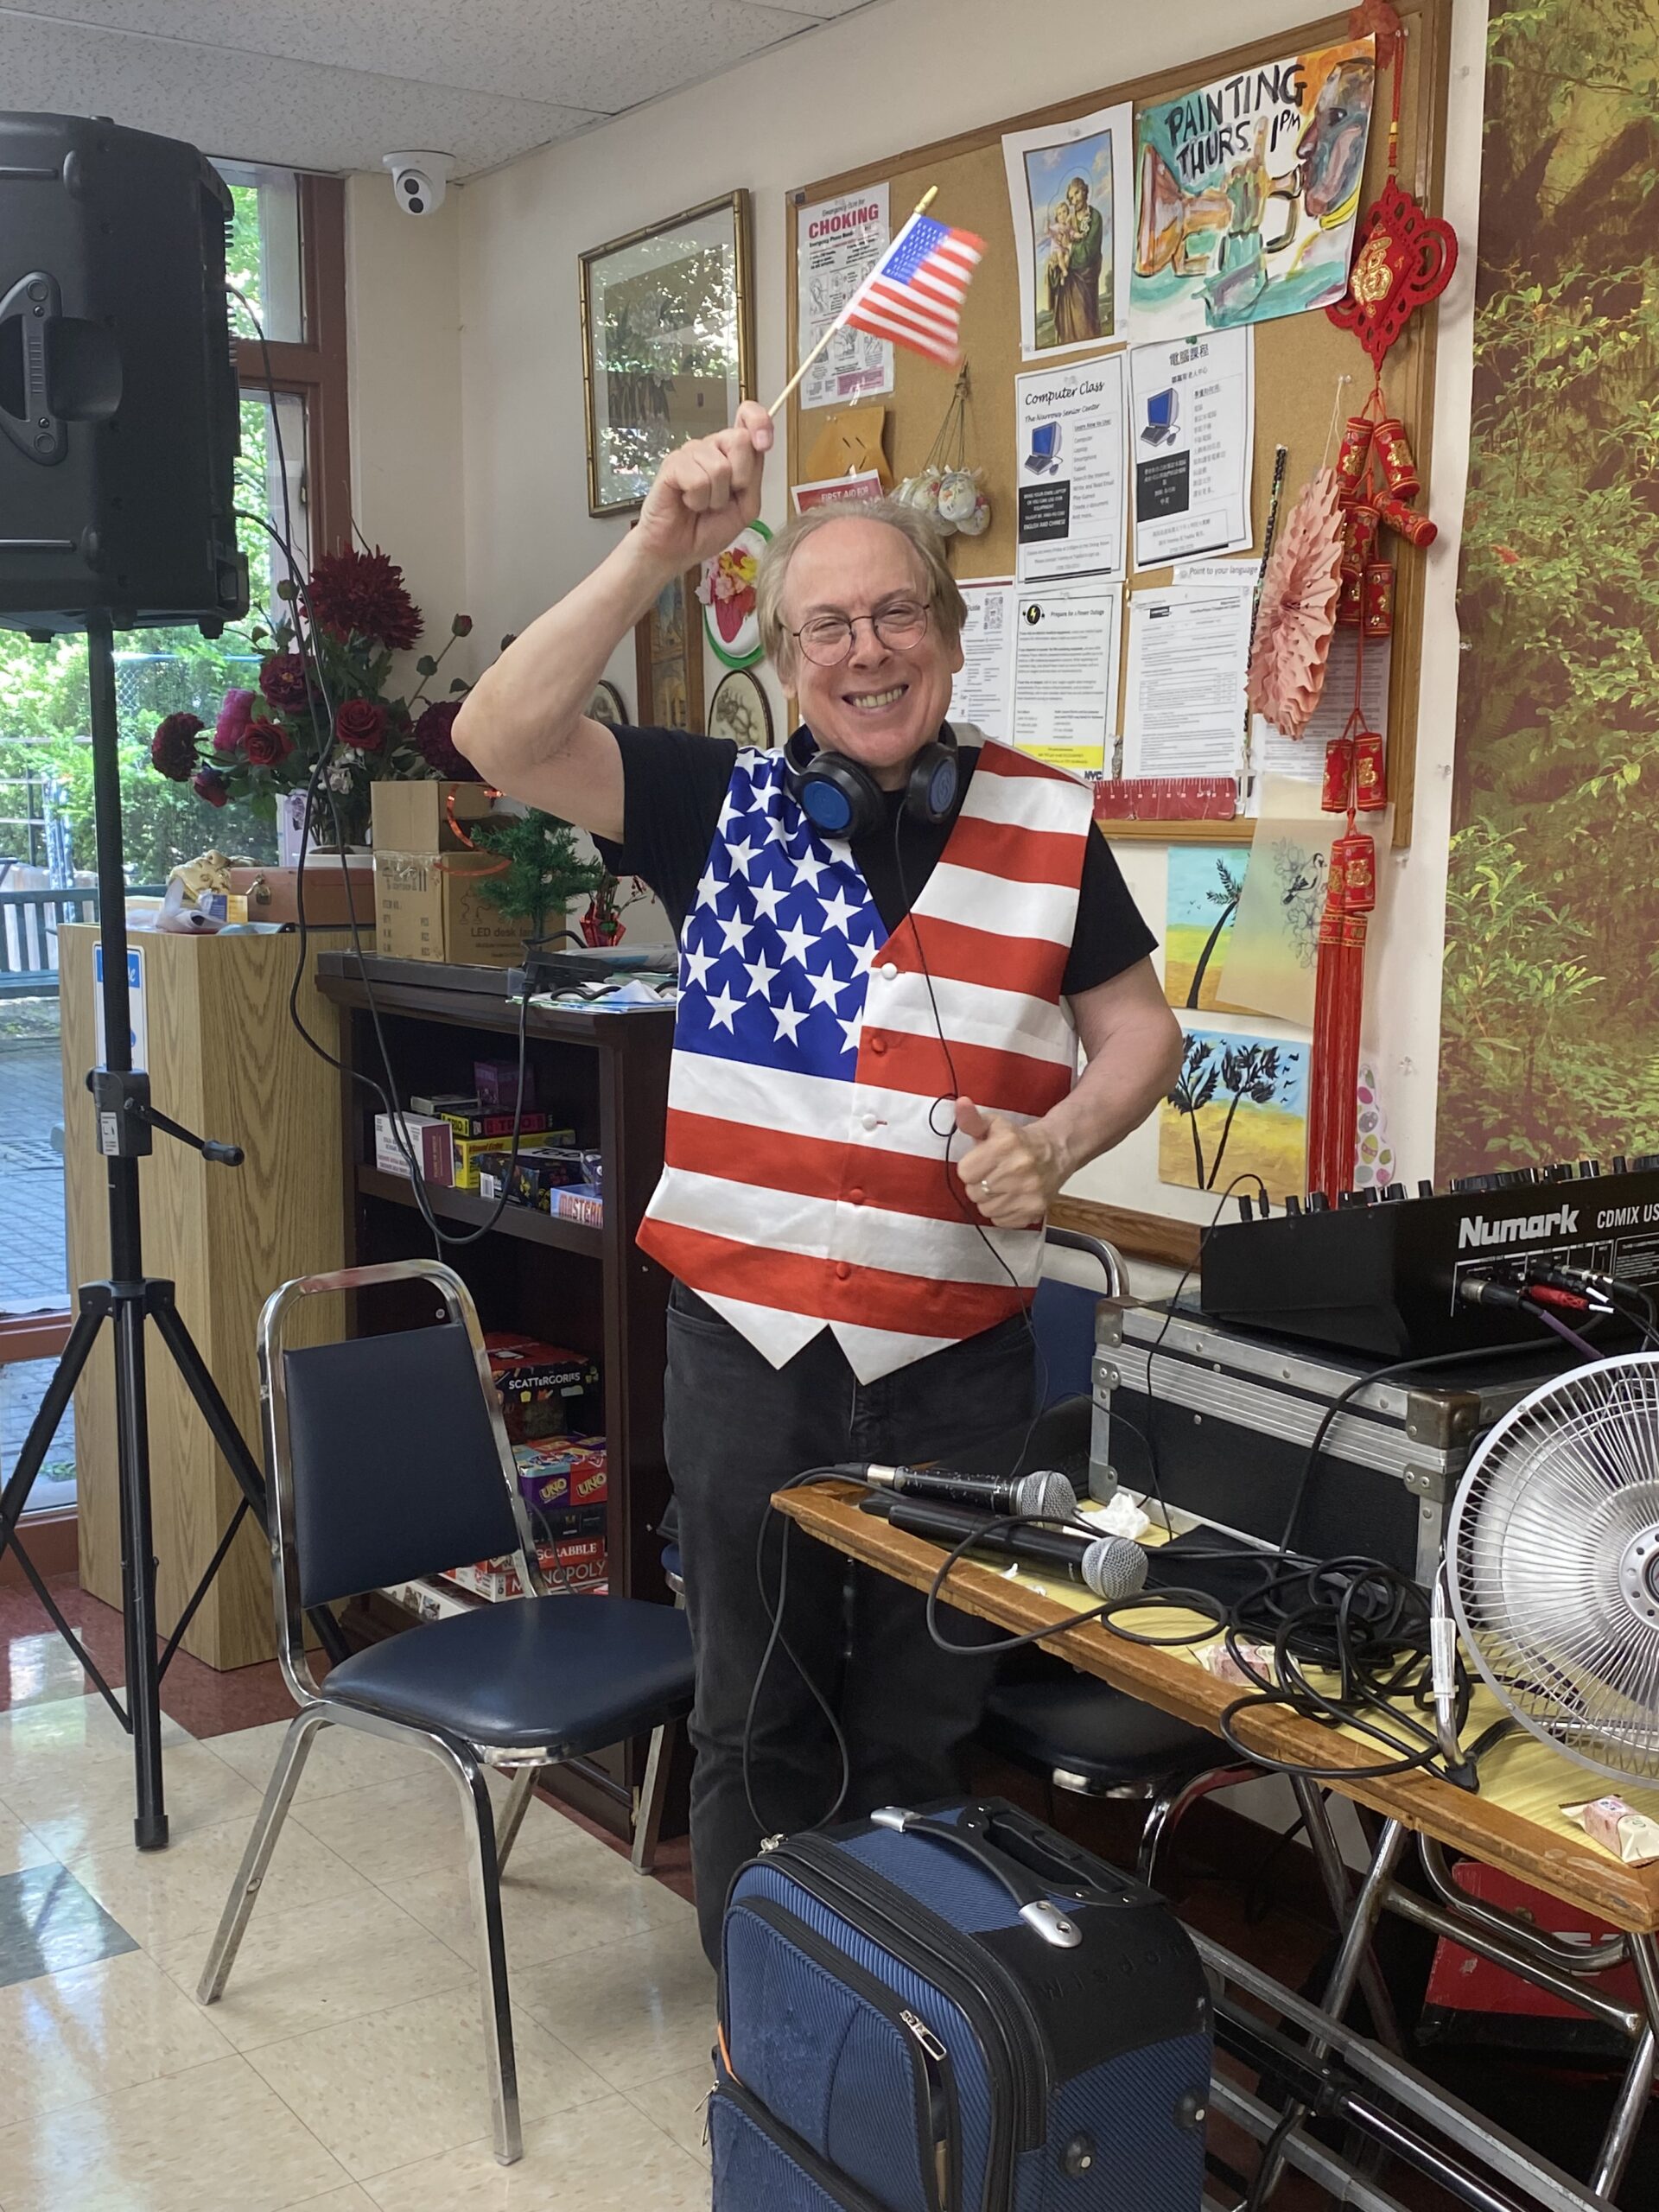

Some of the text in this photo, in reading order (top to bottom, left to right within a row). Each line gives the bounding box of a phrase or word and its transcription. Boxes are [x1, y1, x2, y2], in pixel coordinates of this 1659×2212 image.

[1166, 65, 1306, 146] PAINTING
[1268, 108, 1301, 152] 1PM
[809, 203, 879, 238] CHOKING
[1025, 380, 1105, 406] Computer Class
[1063, 407, 1081, 416] Senior
[821, 486, 869, 503] FIRST AID FOR
[1189, 566, 1206, 575] Point
[1229, 565, 1258, 576] language
[1090, 608, 1104, 617] Outage
[1084, 771, 1103, 780] NYC
[471, 926, 491, 938] LED
[493, 926, 513, 938] desk
[1458, 1204, 1580, 1249] Numark
[1597, 1205, 1640, 1229] CDMIX
[509, 1372, 581, 1390] SCATTERGORIES
[539, 1477, 568, 1501] UNO
[576, 1471, 607, 1498] UNO
